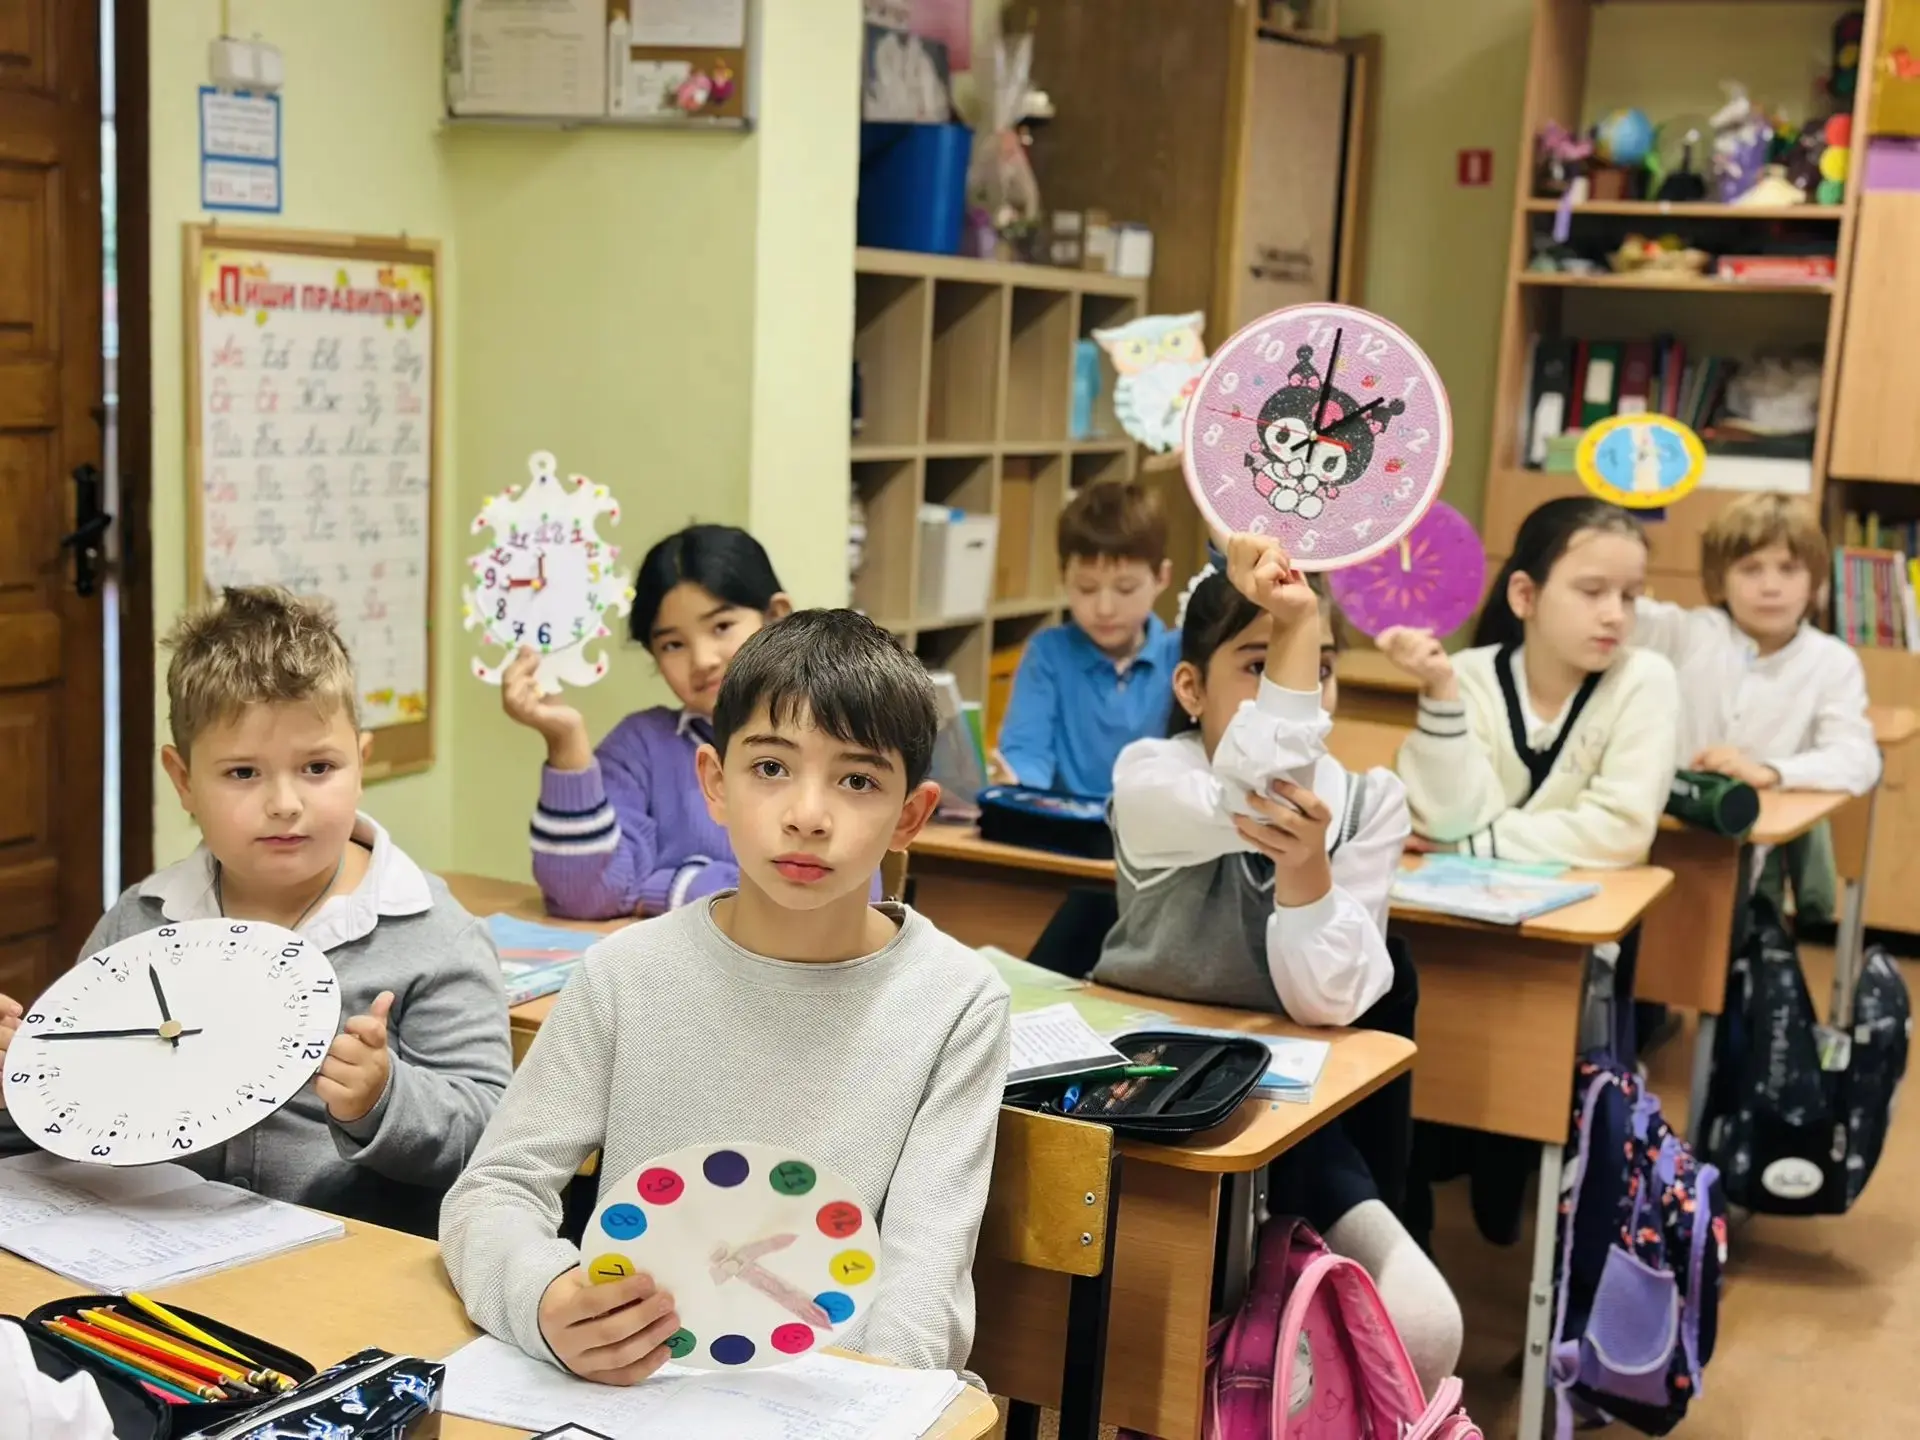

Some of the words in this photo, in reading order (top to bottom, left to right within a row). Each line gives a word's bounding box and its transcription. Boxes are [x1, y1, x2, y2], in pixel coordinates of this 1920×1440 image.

[1306, 320, 1333, 348] 11
[1254, 332, 1285, 363] 10
[1357, 332, 1388, 364] 12
[1220, 372, 1240, 395] 9
[1402, 376, 1420, 396] 1
[1203, 423, 1223, 446] 8
[1406, 428, 1430, 453] 2
[1213, 474, 1235, 496] 7
[1394, 477, 1414, 500] 3
[1353, 518, 1374, 539] 4
[1299, 529, 1320, 551] 5
[484, 567, 497, 589] 9
[496, 597, 507, 621] 8
[512, 620, 525, 642] 7
[537, 622, 552, 645] 6
[158, 927, 177, 938] 8
[230, 925, 248, 935] 9
[280, 940, 305, 958] 10
[93, 955, 110, 968] 7
[312, 978, 335, 995] 11
[26, 1013, 45, 1025] 6
[301, 1039, 326, 1061] 12
[11, 1072, 31, 1084] 5
[259, 1097, 276, 1107] 1
[44, 1123, 62, 1136] 4
[91, 1145, 112, 1157] 3
[172, 1138, 194, 1151] 2
[646, 1176, 675, 1193] 9
[608, 1212, 639, 1227] 8
